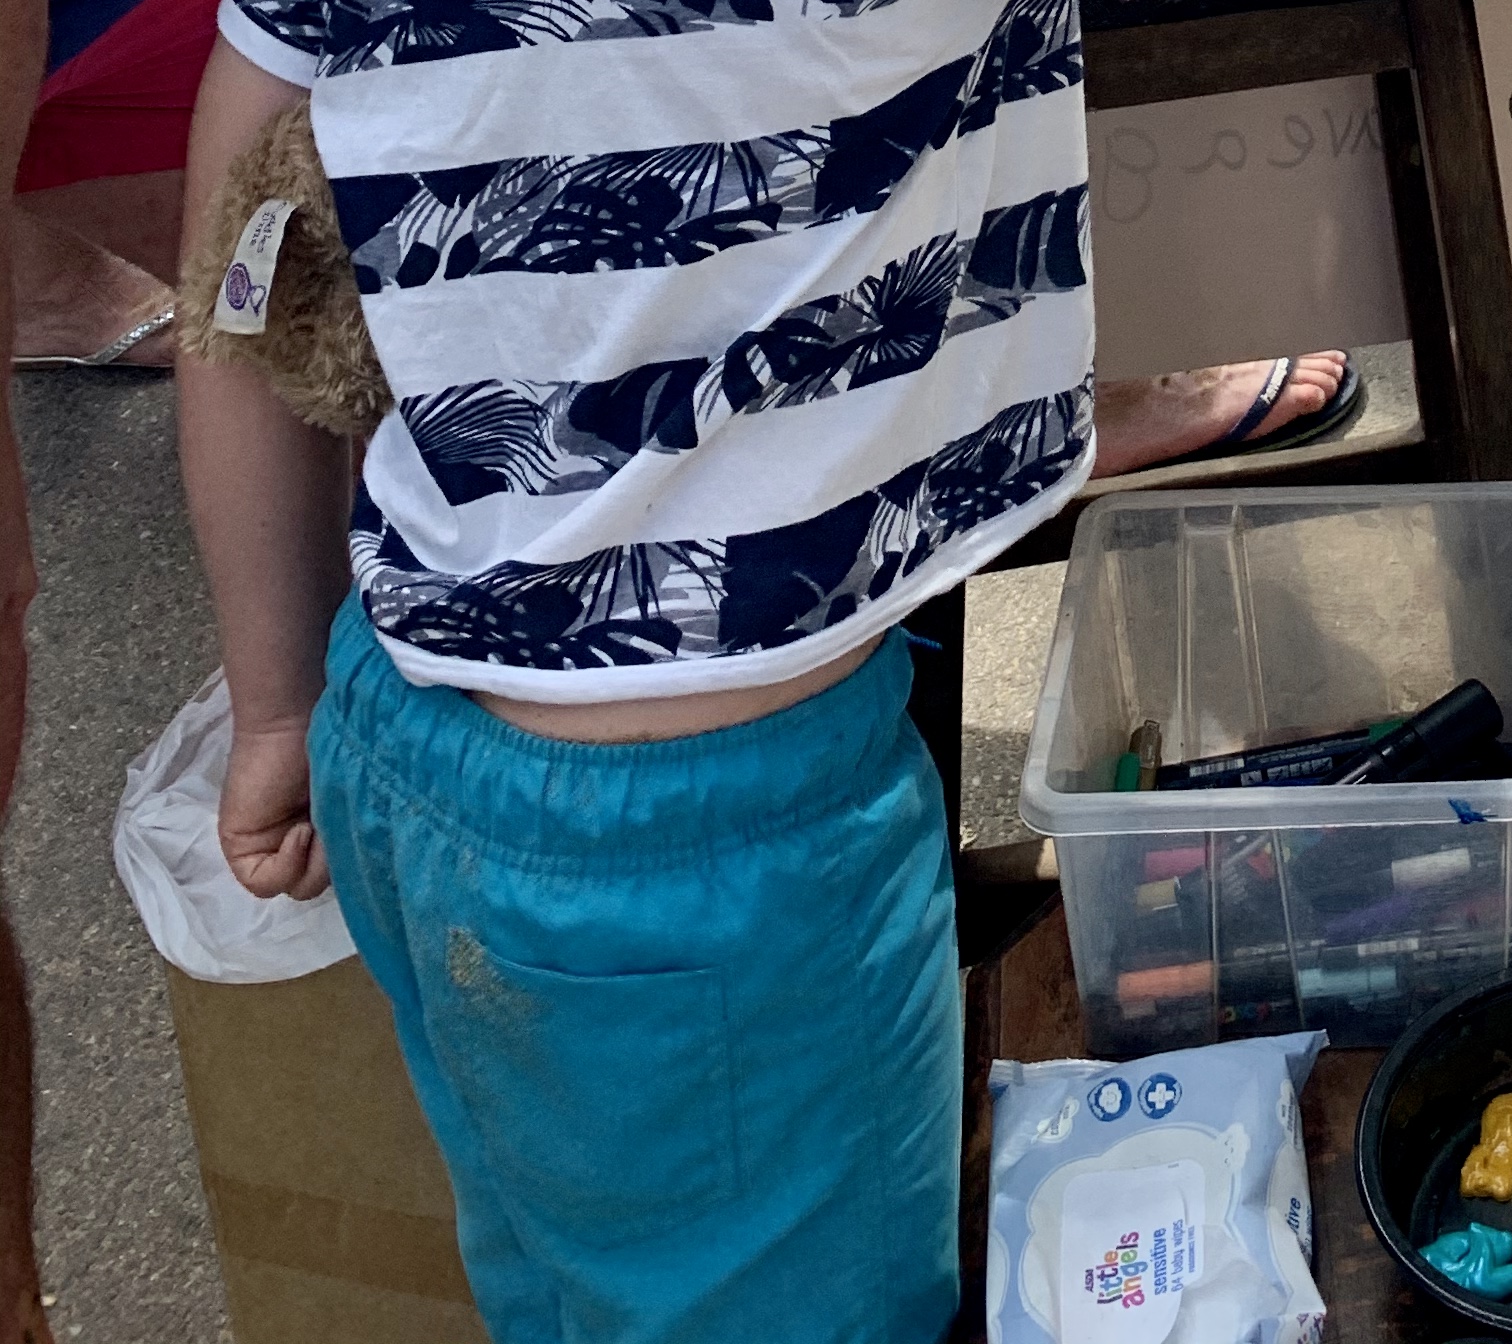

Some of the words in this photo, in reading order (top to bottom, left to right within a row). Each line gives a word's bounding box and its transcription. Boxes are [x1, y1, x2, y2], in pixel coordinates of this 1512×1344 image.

[1085, 1268, 1094, 1293] ASDA
[1096, 1249, 1123, 1304] little
[1115, 1231, 1148, 1309] angels
[1149, 1227, 1168, 1296] sensitive
